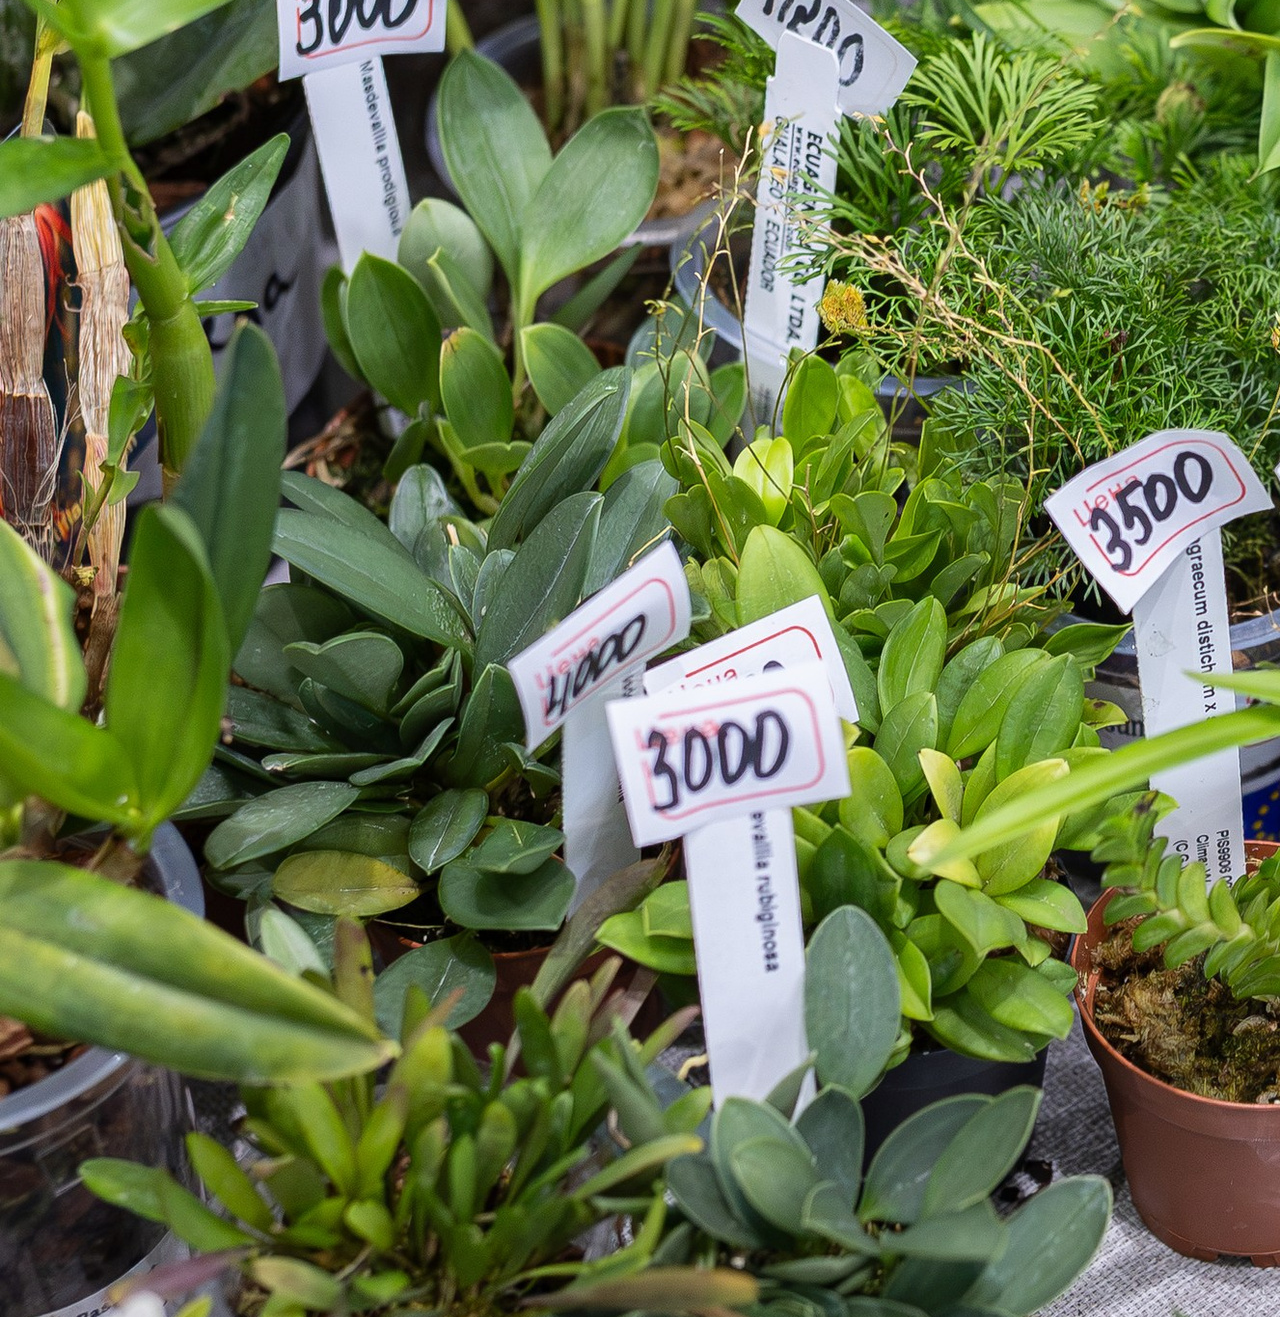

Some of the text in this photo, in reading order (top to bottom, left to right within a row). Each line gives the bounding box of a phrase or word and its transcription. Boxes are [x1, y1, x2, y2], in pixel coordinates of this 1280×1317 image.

[760, 219, 780, 293] ECUADOR
[1090, 451, 1213, 572] 3500
[545, 614, 646, 716] 4000
[1197, 620, 1216, 699] distichm
[648, 710, 789, 811] 3000
[750, 812, 780, 973] evallia rubiginosa
